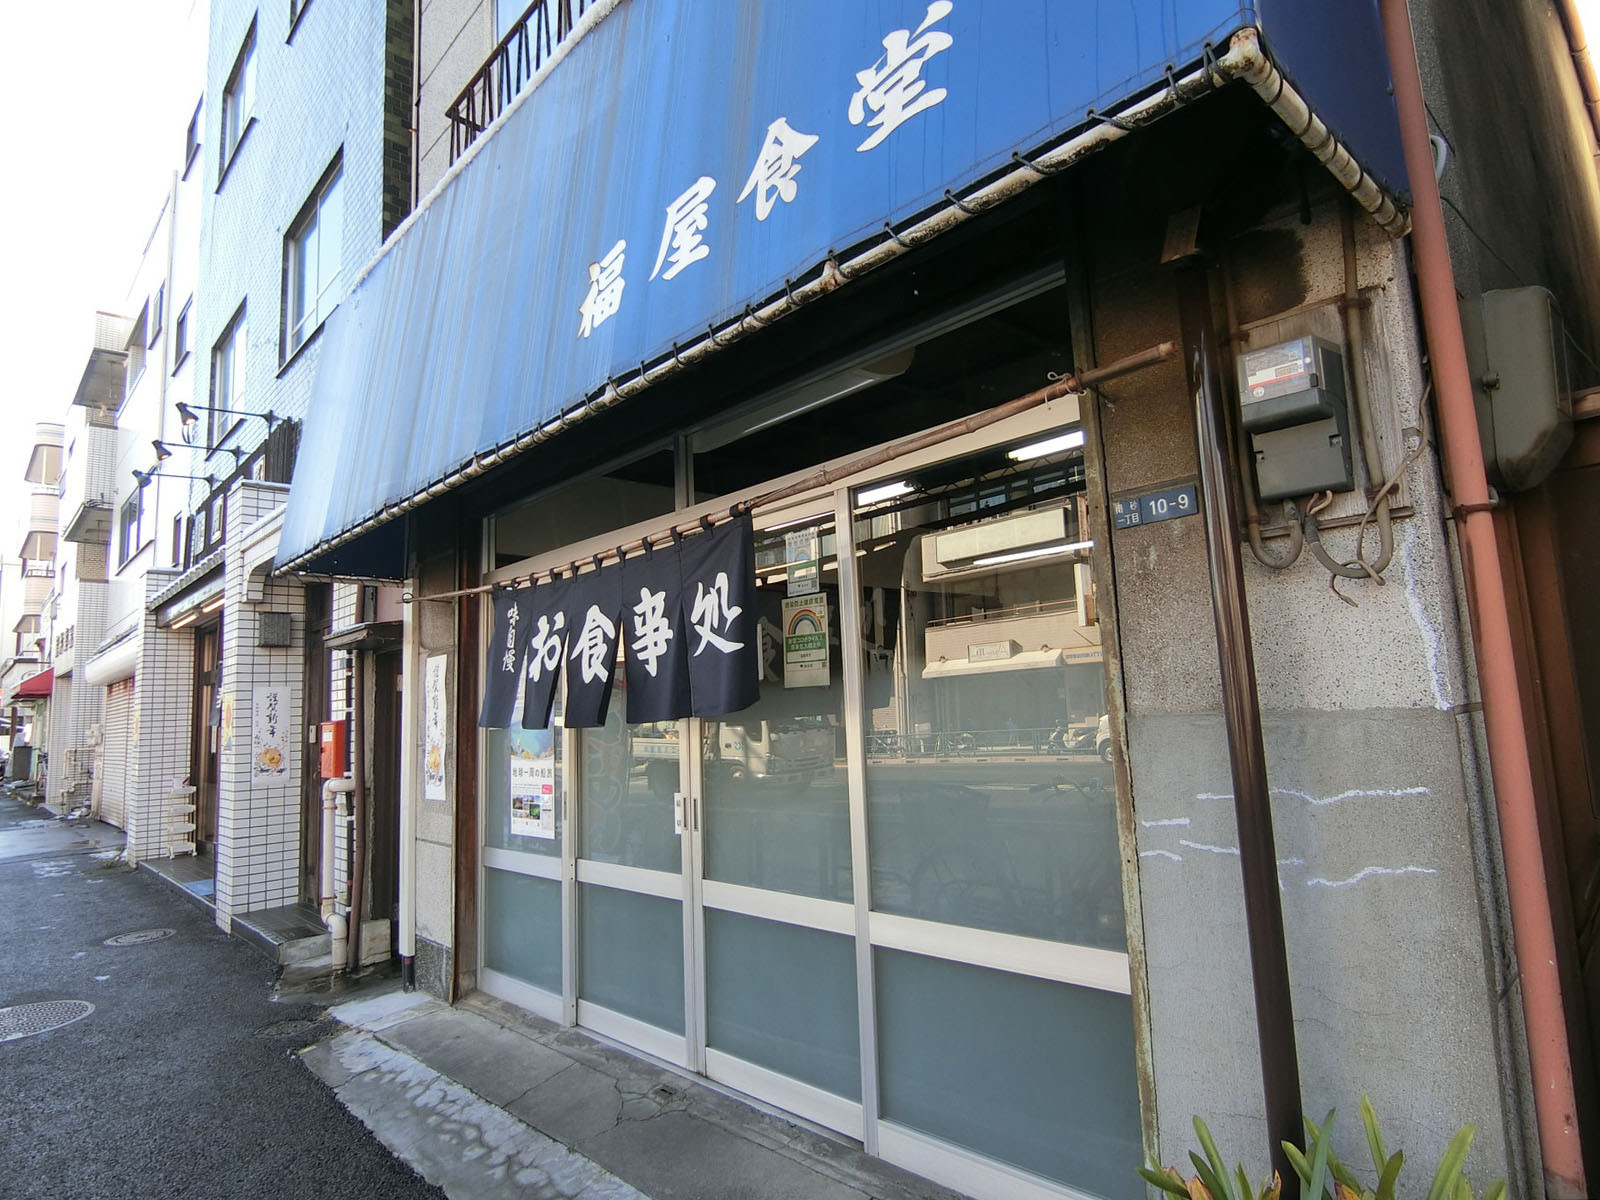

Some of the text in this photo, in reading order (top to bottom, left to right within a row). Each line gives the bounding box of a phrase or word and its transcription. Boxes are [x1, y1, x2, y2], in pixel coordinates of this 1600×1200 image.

[576, 0, 954, 339] 福屋食堂
[1118, 512, 1140, 525] 一丁目
[1149, 494, 1189, 516] 10-9
[502, 601, 520, 673] 味自慢
[528, 572, 745, 684] お食事処
